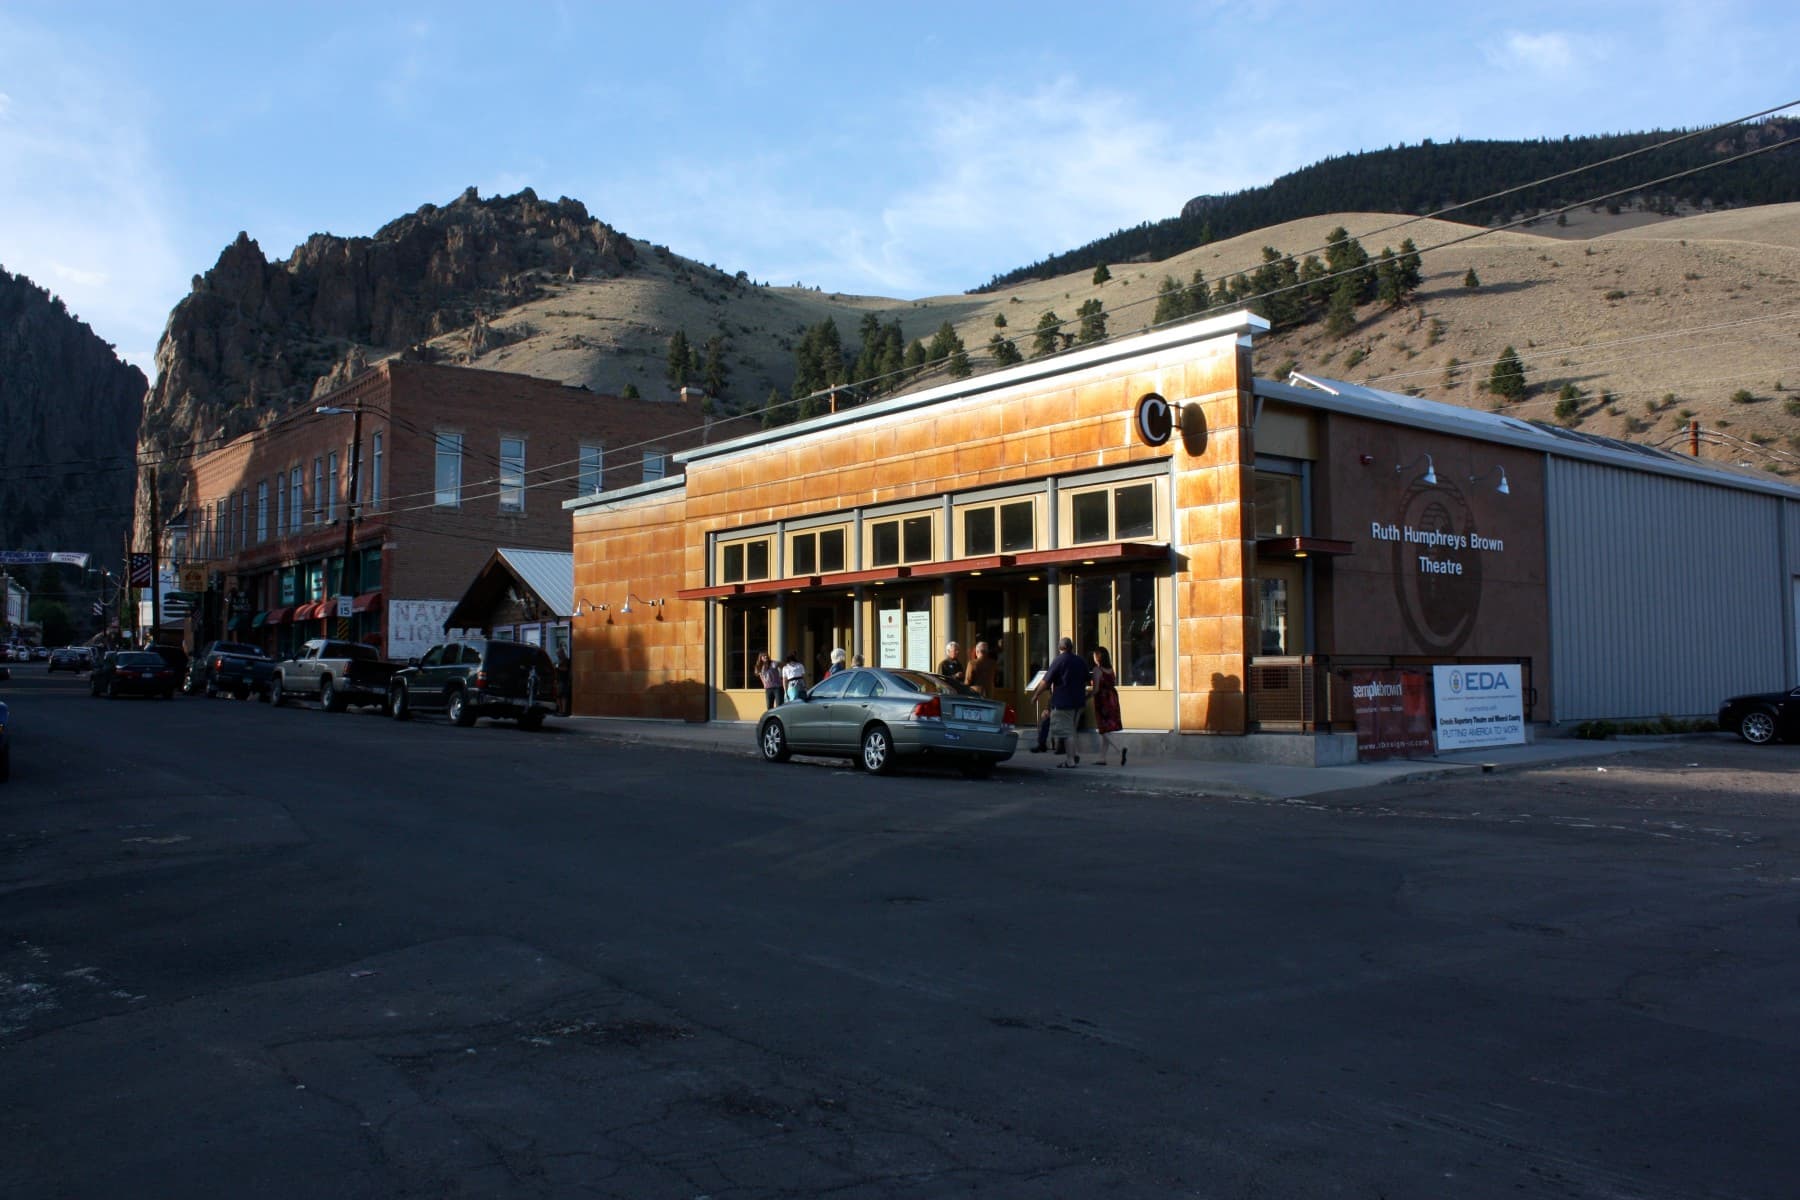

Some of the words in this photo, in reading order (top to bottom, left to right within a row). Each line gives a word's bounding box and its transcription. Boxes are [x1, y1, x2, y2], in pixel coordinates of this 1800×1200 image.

[1141, 399, 1167, 442] C
[1372, 522, 1400, 541] Ruth
[1404, 526, 1467, 550] Humphreys
[1470, 533, 1504, 552] Brown
[1418, 556, 1463, 575] Theatre
[340, 606, 350, 615] 15
[1465, 671, 1510, 690] EDA
